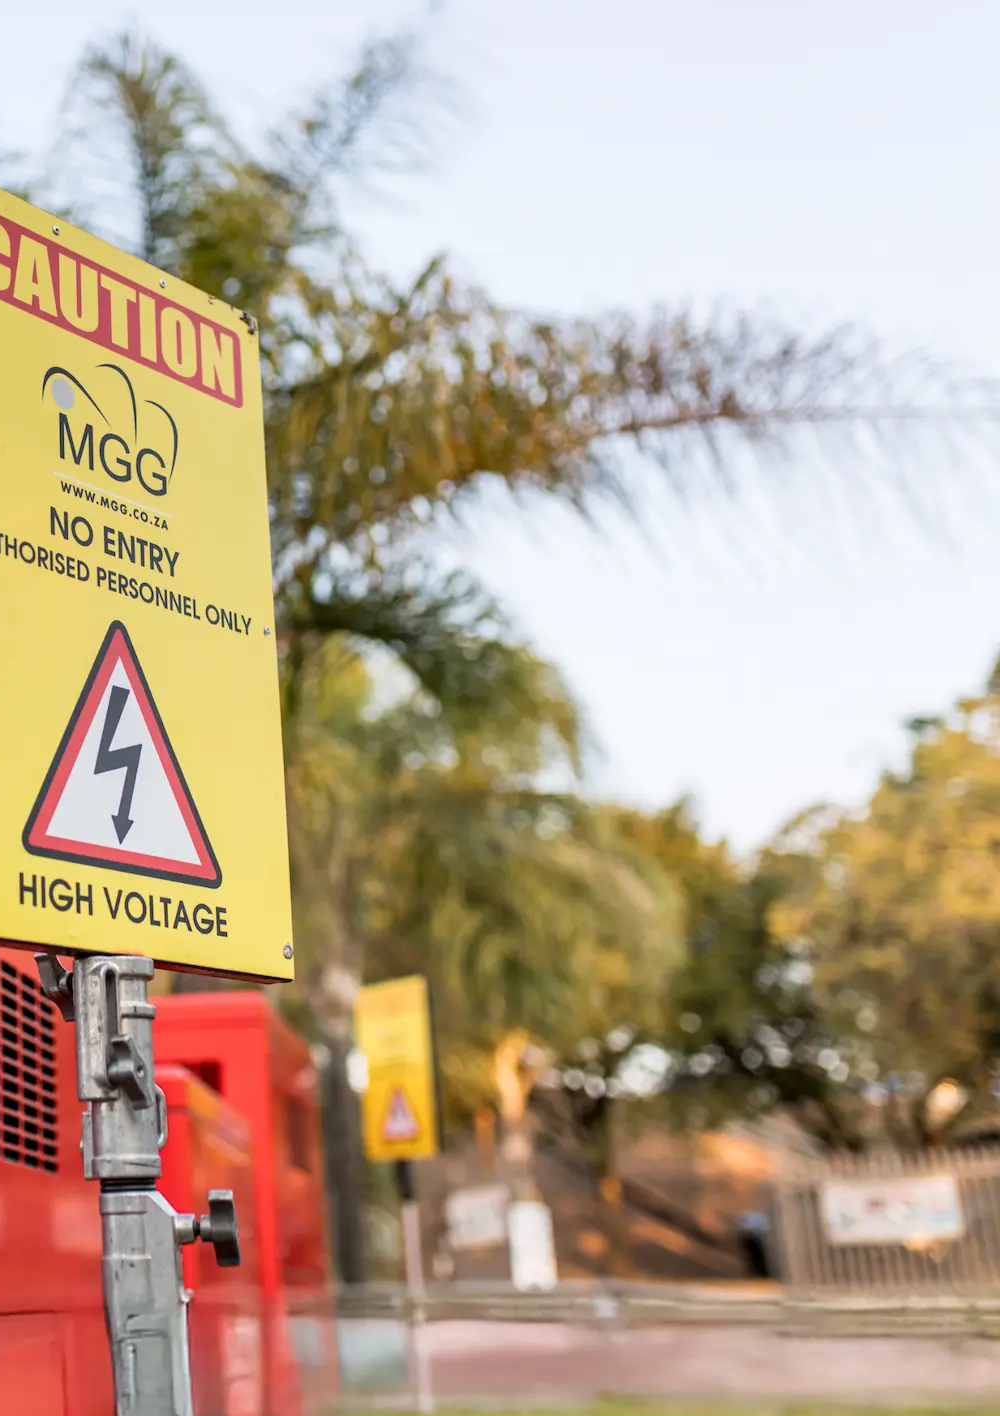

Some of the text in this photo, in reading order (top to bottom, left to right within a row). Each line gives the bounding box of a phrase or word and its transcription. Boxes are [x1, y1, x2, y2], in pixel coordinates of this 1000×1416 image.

[58, 411, 168, 497] MGG
[60, 480, 169, 531] WWW.MGG.CO.ZA
[50, 506, 180, 578] NO ENTRY
[96, 567, 201, 620] PERSONNEL
[205, 603, 253, 636] ONLY
[18, 872, 229, 938] HIGH VOLTAGE
